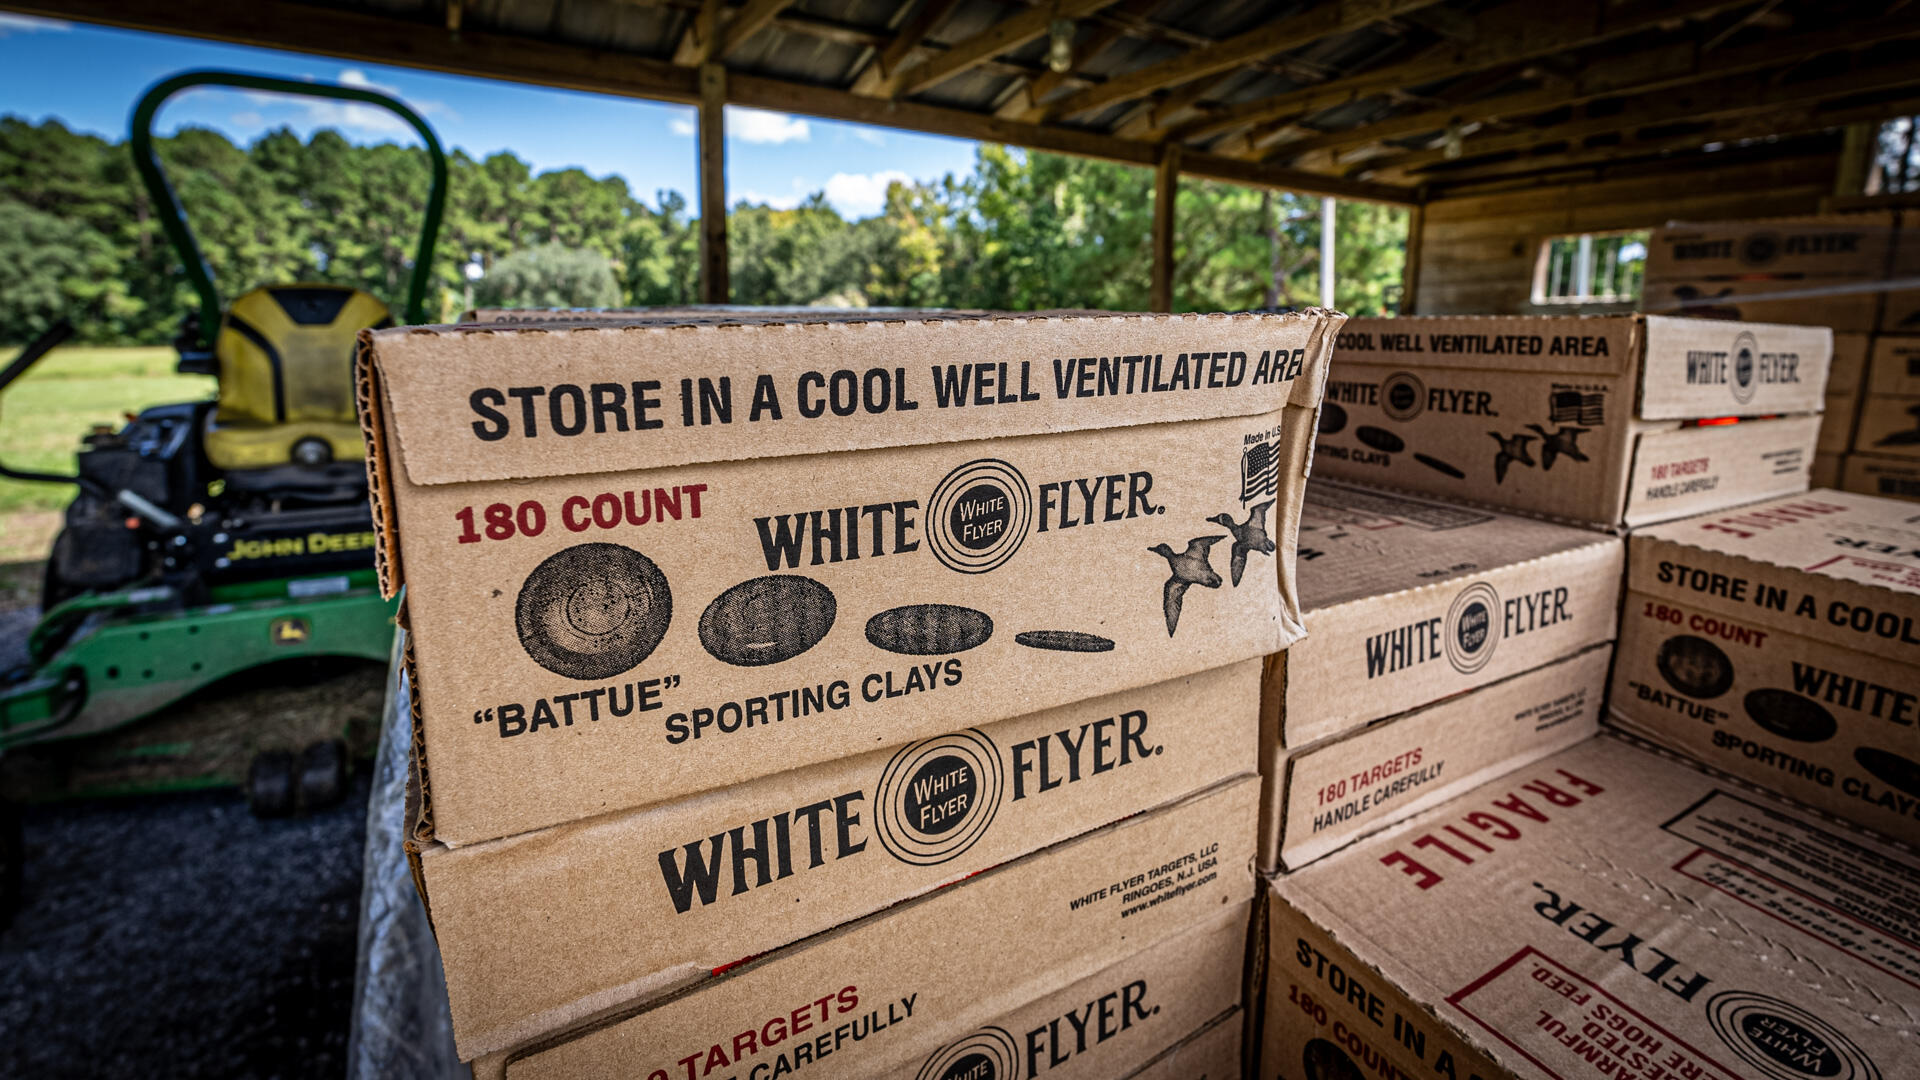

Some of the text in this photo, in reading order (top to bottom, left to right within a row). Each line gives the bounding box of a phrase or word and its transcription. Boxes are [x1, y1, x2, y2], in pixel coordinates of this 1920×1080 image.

[1336, 333, 1609, 356] COOL WELL VENTILATED AREA
[1686, 350, 1728, 385] WHITE
[468, 380, 664, 442] STORE
[680, 376, 732, 427] IN
[749, 374, 784, 422] A
[797, 366, 919, 419] COOL
[931, 360, 1040, 408] WELL
[1053, 350, 1247, 399] VENTILATED
[1327, 381, 1380, 406] WHITE
[1243, 432, 1264, 445] Made
[308, 531, 375, 554] DEER
[455, 483, 708, 544] 180 COUNT
[753, 500, 921, 572] WHITE
[1643, 602, 1768, 649] 180 COUNT
[1657, 560, 1920, 646] STORE IN A COOL
[1365, 616, 1443, 680] WHITE
[665, 658, 963, 745] SPORTING CLAYS
[1791, 660, 1918, 727] WHITE
[1317, 748, 1423, 806] 180 TARGETS
[1711, 729, 1836, 788] SPORTING
[1313, 760, 1445, 834] HANDLE CAREFULLY
[1379, 768, 1606, 891] FRAGILE
[657, 789, 869, 916] WHITE
[1070, 842, 1219, 911] WHITE FLYER TARGETS, LLC
[1122, 876, 1175, 905] RINGOES,
[1197, 856, 1218, 873] USA
[1120, 871, 1218, 918] www.whiteflyer.com
[1834, 897, 1920, 942] ARNING
[677, 985, 859, 1080] TARGETS
[749, 992, 918, 1080] CAREFULLY
[1288, 984, 1328, 1027] 180
[1296, 938, 1457, 1080] STORE IN A
[1531, 962, 1664, 1056] HOGS FEED.
[1535, 1010, 1640, 1080] ARMFUL
[1582, 1015, 1674, 1080] ESTED.
